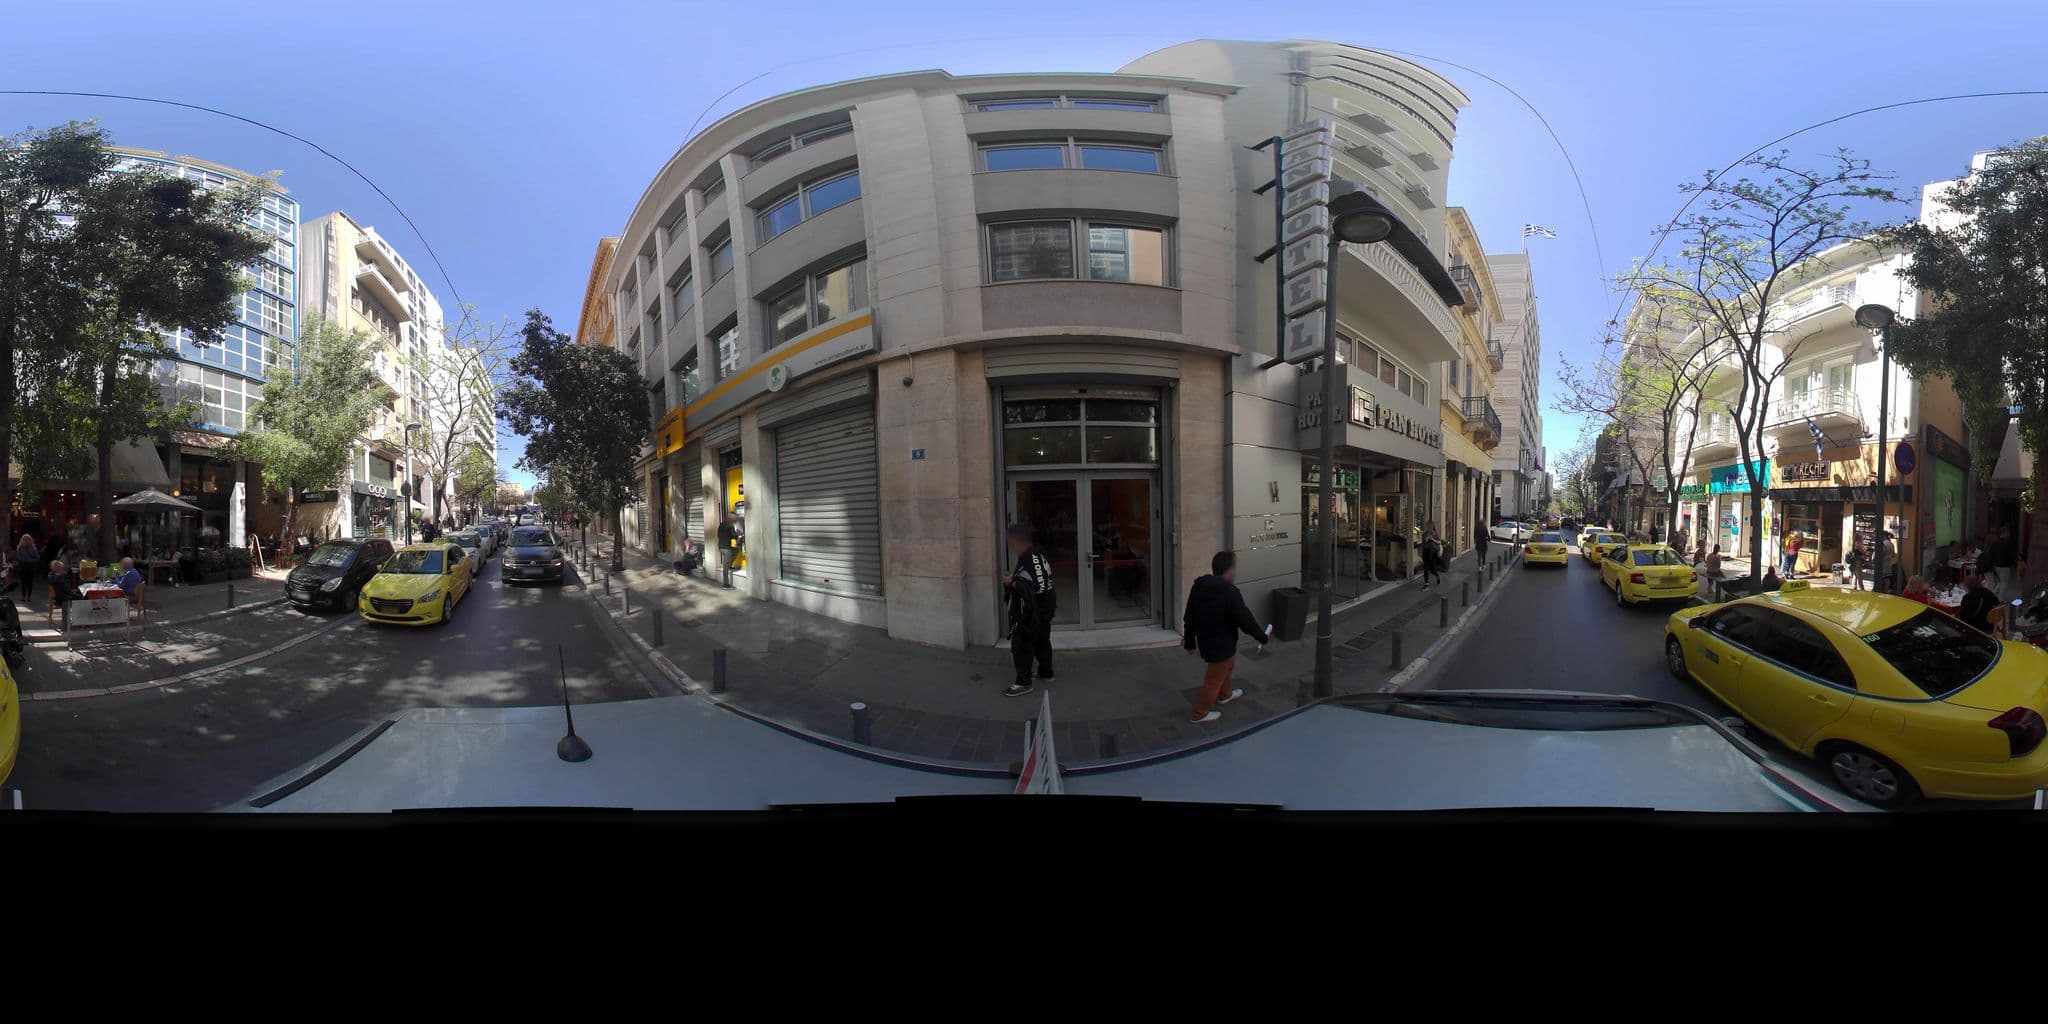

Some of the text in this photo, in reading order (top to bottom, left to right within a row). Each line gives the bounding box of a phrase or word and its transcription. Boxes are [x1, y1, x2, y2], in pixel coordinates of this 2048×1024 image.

[1286, 185, 1313, 353] HOTEL
[1376, 404, 1441, 449] PAN HOTEL
[1031, 553, 1043, 577] BODY
[1791, 581, 1807, 589] TAXI
[1862, 633, 1881, 644] 160
